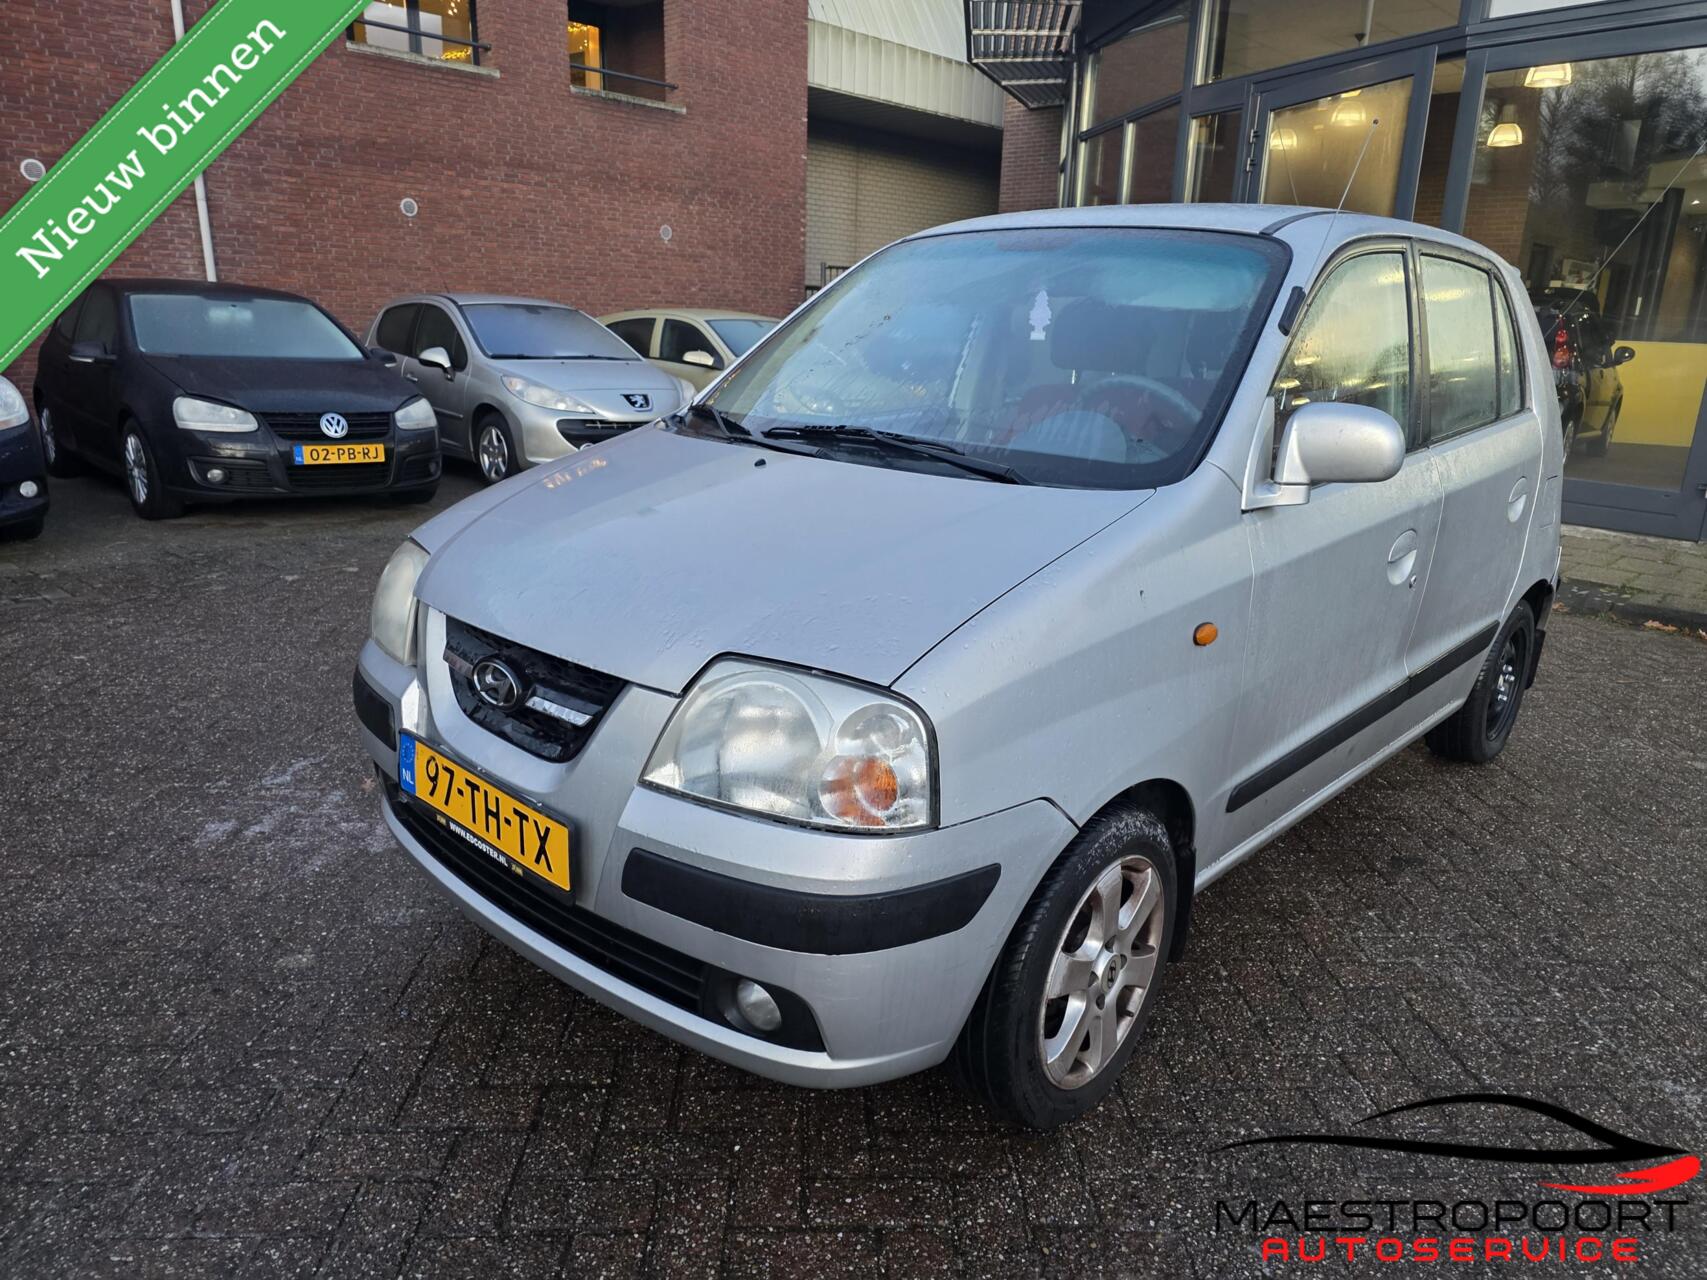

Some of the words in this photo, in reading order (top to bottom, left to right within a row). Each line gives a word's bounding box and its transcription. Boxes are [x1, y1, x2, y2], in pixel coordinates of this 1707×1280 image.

[309, 446, 379, 461] 02-PB-RJ
[402, 768, 415, 785] NL
[425, 754, 553, 874] 97-TH-TX
